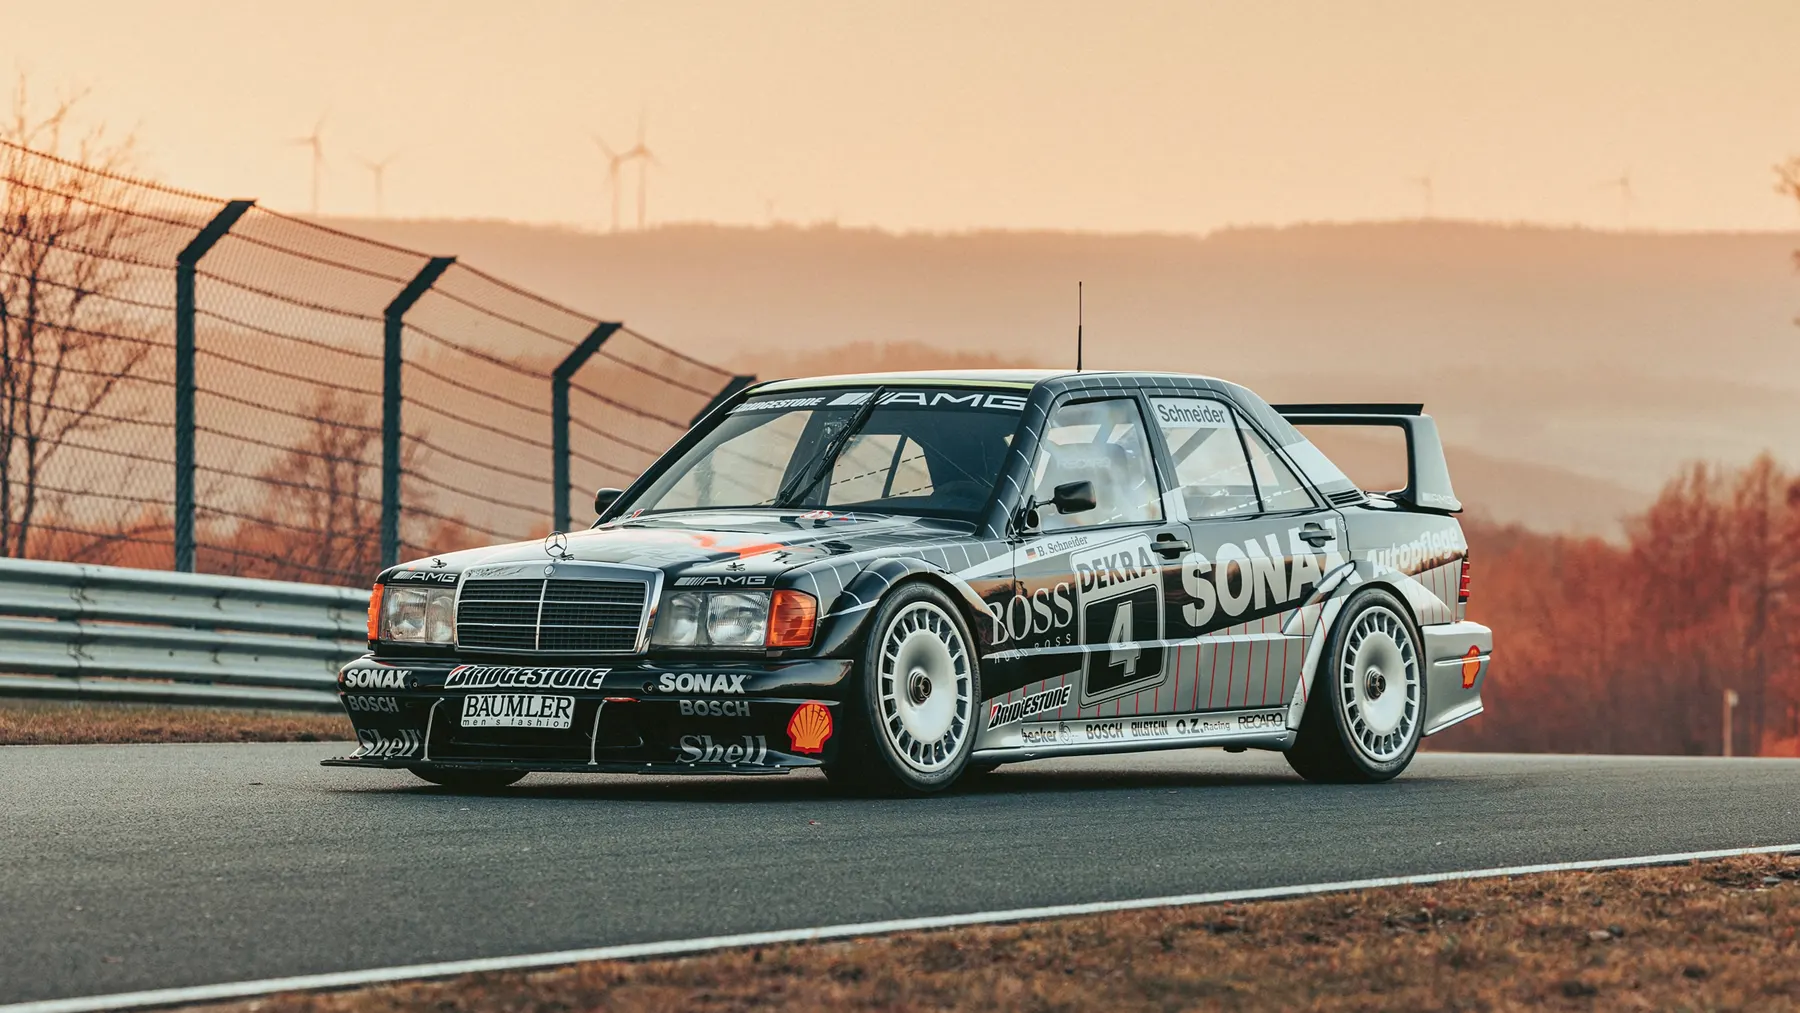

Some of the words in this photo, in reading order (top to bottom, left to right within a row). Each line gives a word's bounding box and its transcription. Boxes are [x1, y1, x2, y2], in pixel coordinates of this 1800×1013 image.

[880, 392, 1028, 411] AMG
[1157, 403, 1226, 424] Schneider
[1037, 546, 1047, 557] B.
[1048, 535, 1089, 553] Schneider
[408, 571, 458, 583] AMG
[1076, 546, 1158, 594] DEKRA
[1182, 517, 1362, 627] SONAX
[700, 575, 767, 586] AMG
[988, 582, 1074, 646] BOSS
[1108, 600, 1142, 678] 4
[345, 669, 409, 689] SONAX
[444, 665, 612, 689] BRIDGESTONE
[658, 673, 746, 694] SONAX
[347, 695, 399, 713] BOSCH
[463, 694, 571, 720] BÄUMLER
[680, 700, 750, 717] BOSCH
[510, 717, 570, 728] fashion
[1085, 722, 1124, 740] BOSCH
[1130, 719, 1169, 737] BILSTEIN
[1203, 720, 1230, 731] Racing
[1238, 712, 1283, 730] RECARO
[349, 728, 420, 758] Shell
[1021, 727, 1057, 744] becker
[675, 735, 767, 765] Shell
